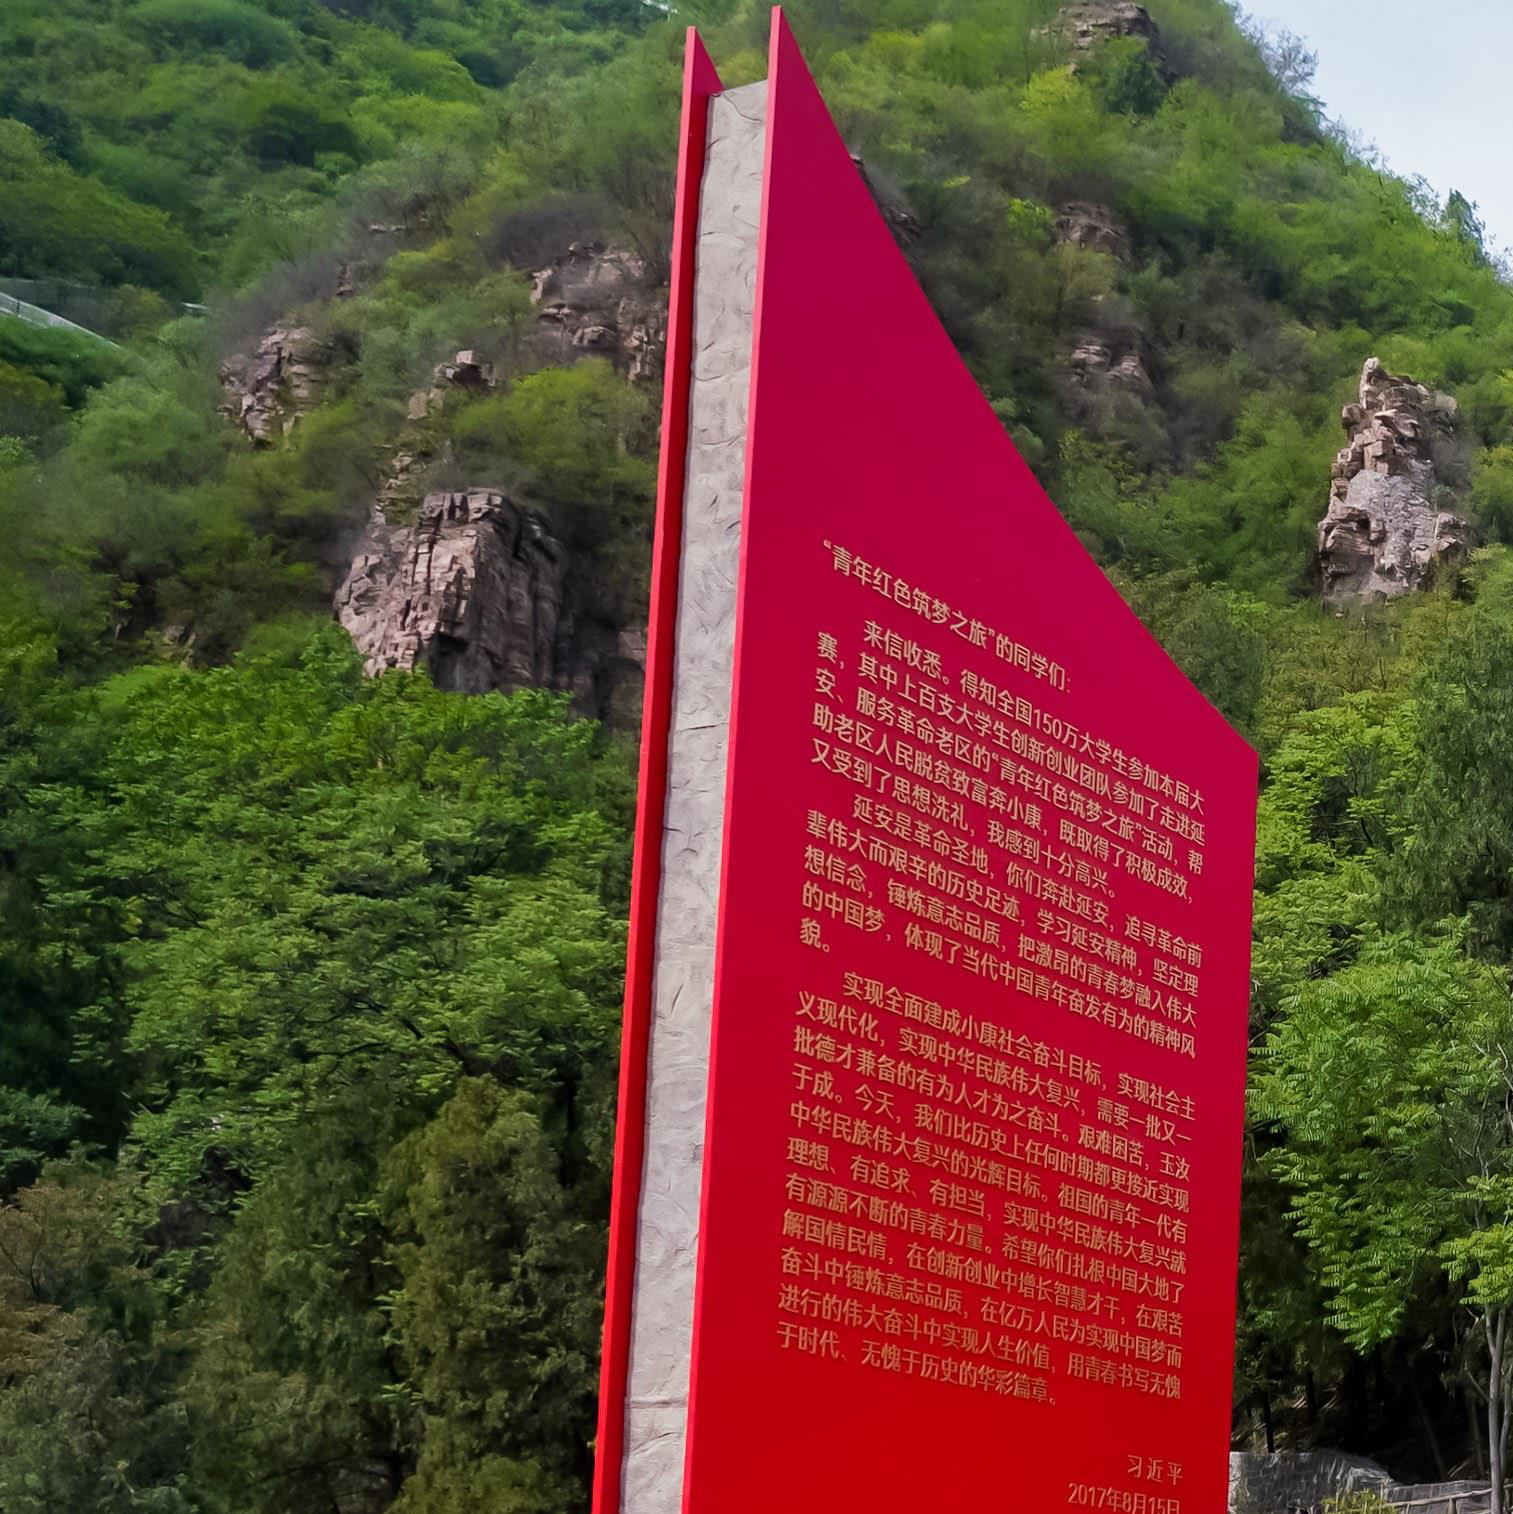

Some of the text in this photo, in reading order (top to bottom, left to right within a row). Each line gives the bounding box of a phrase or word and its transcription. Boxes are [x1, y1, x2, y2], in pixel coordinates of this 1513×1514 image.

[817, 631, 1205, 846] 赛，其中上百支大学生创新创业团队参加了走进延
[864, 620, 1204, 815] 来信收悉。得知全国150万大学生参加本届大
[811, 738, 1115, 898] 又受到了思想洗礼，我感到十分高兴。
[813, 702, 1193, 904] 助老区人民脱贫致富奔小康，既取得了积极成效，
[852, 793, 1202, 968] 延安是革命圣地，你们奔赴延安，追寻革命前
[800, 917, 830, 953] 貌。
[802, 881, 1196, 1059] 的中国梦，体现了当代中国青年奋发有为的精神风
[806, 808, 1199, 997] 辈伟大而艰辛的历史足迹，学习延安精神，坚定理
[795, 990, 1192, 1146] 义现代化，实现中华民族伟大复兴，需要一批又一
[842, 971, 1196, 1121] 实现全面建成小康社会奋斗目标，实现社会主
[789, 1099, 1188, 1245] 中华民族伟大复兴的光辉目标。祖国的青年一代有
[792, 1062, 1190, 1213] 于成。今天，我们比历史上任何时期都更接近实现
[1127, 1454, 1183, 1486] 习近平
